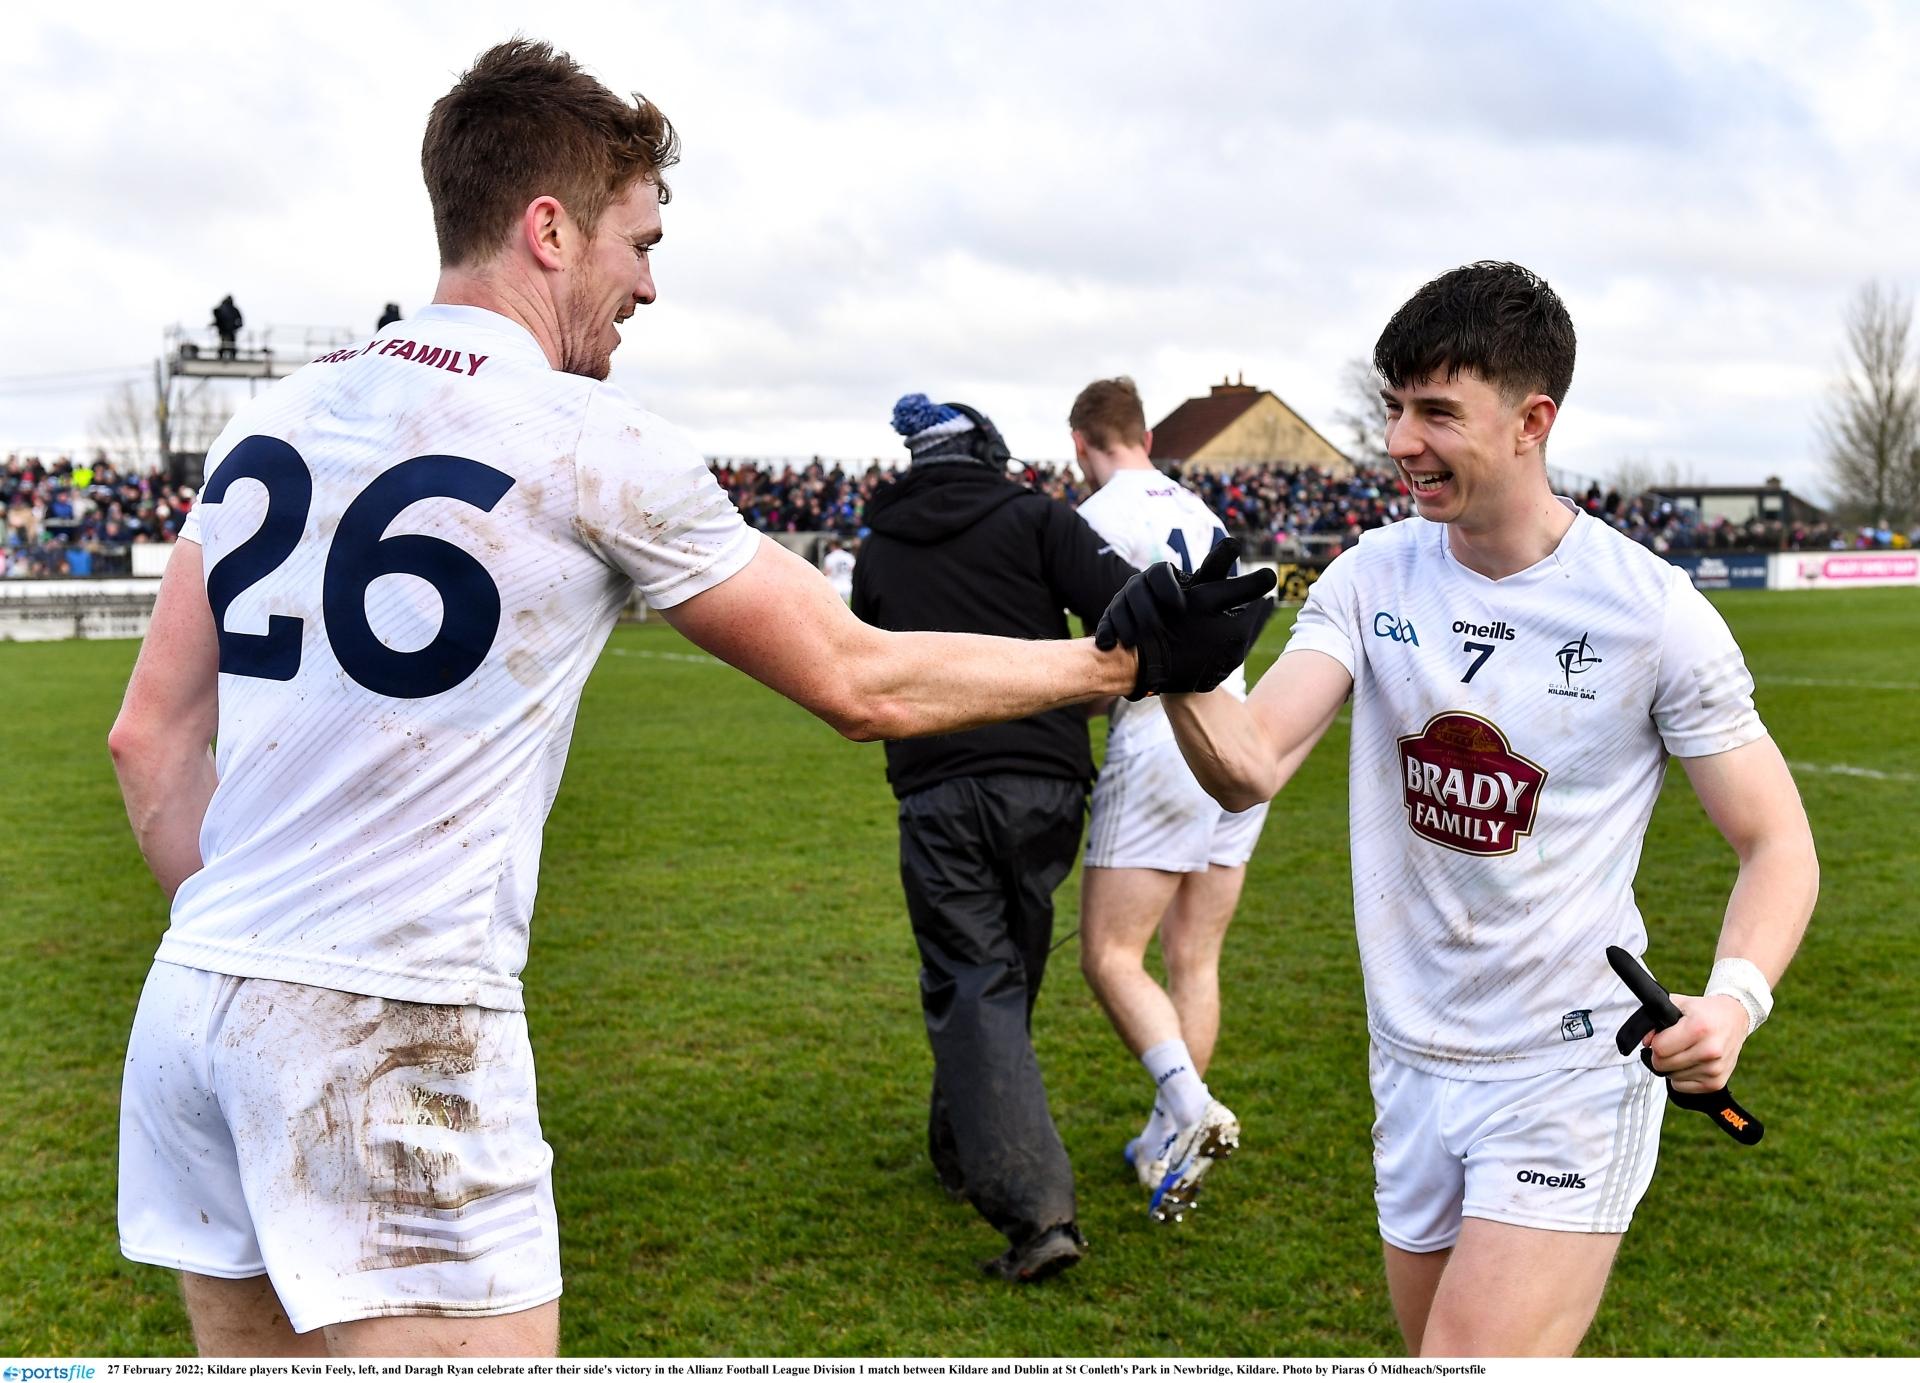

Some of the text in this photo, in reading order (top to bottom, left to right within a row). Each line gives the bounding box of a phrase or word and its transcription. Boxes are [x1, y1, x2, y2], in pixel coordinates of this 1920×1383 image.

[378, 338, 489, 377] FAMILY
[201, 434, 517, 699] 26
[1460, 641, 1496, 684] 7
[1547, 687, 1596, 701] KILDARE GAA
[1406, 754, 1530, 815] BRADY
[1415, 801, 1507, 844] FAMILY
[1720, 1107, 1749, 1131] ATAK
